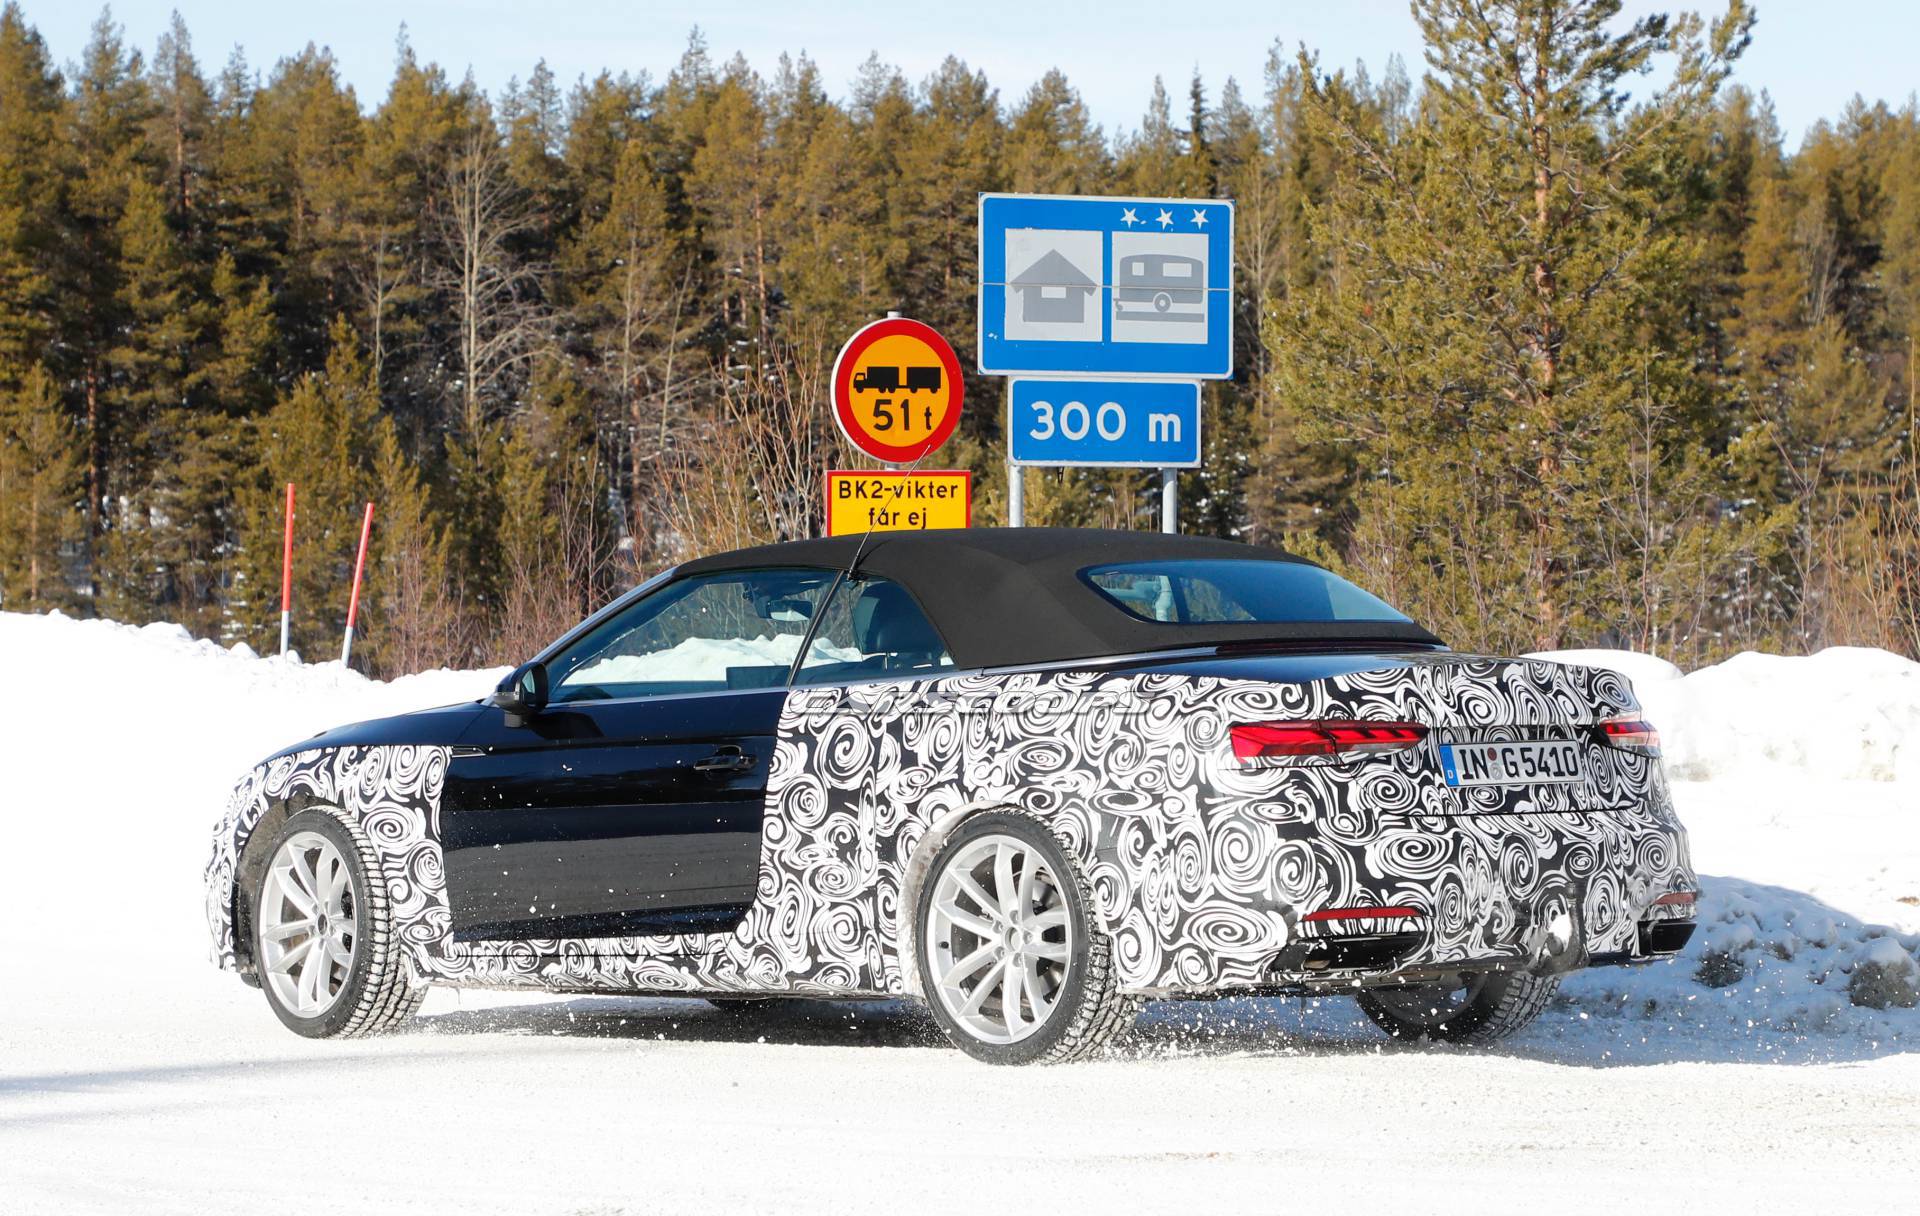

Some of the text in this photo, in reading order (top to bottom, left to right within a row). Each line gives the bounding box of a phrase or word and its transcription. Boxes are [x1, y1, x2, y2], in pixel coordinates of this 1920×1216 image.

[873, 399, 933, 431] 51 t
[1029, 401, 1182, 442] 300 m
[839, 480, 958, 499] BK2-vikter
[908, 508, 927, 530] ej
